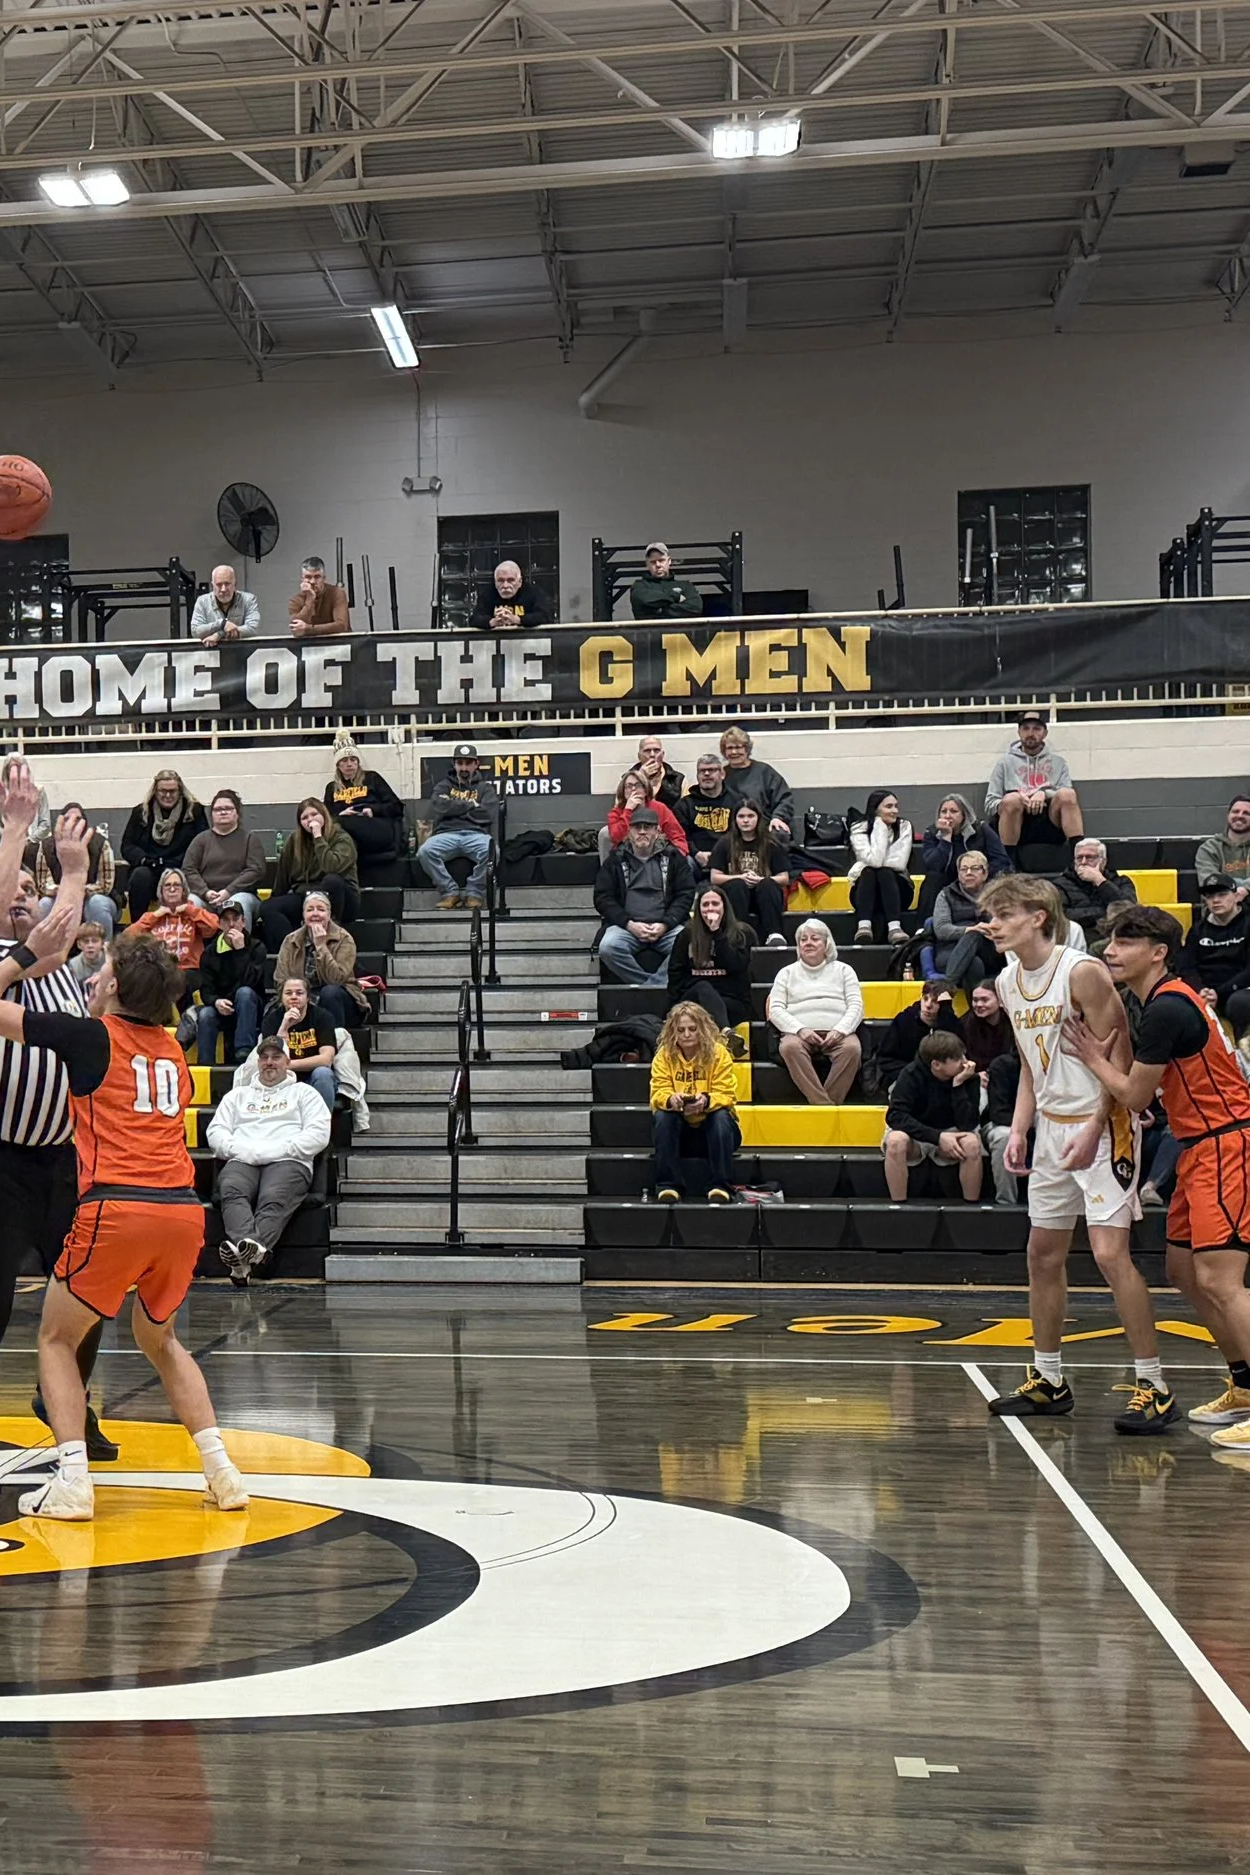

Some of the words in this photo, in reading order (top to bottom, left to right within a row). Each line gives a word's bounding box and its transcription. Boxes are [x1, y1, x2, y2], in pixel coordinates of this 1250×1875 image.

[246, 644, 351, 710] OF
[376, 638, 552, 705] THE
[579, 635, 634, 699] G
[661, 626, 871, 697] MEN
[479, 755, 550, 777] -MEN
[486, 778, 562, 795] TATORS
[131, 1054, 180, 1118] 10
